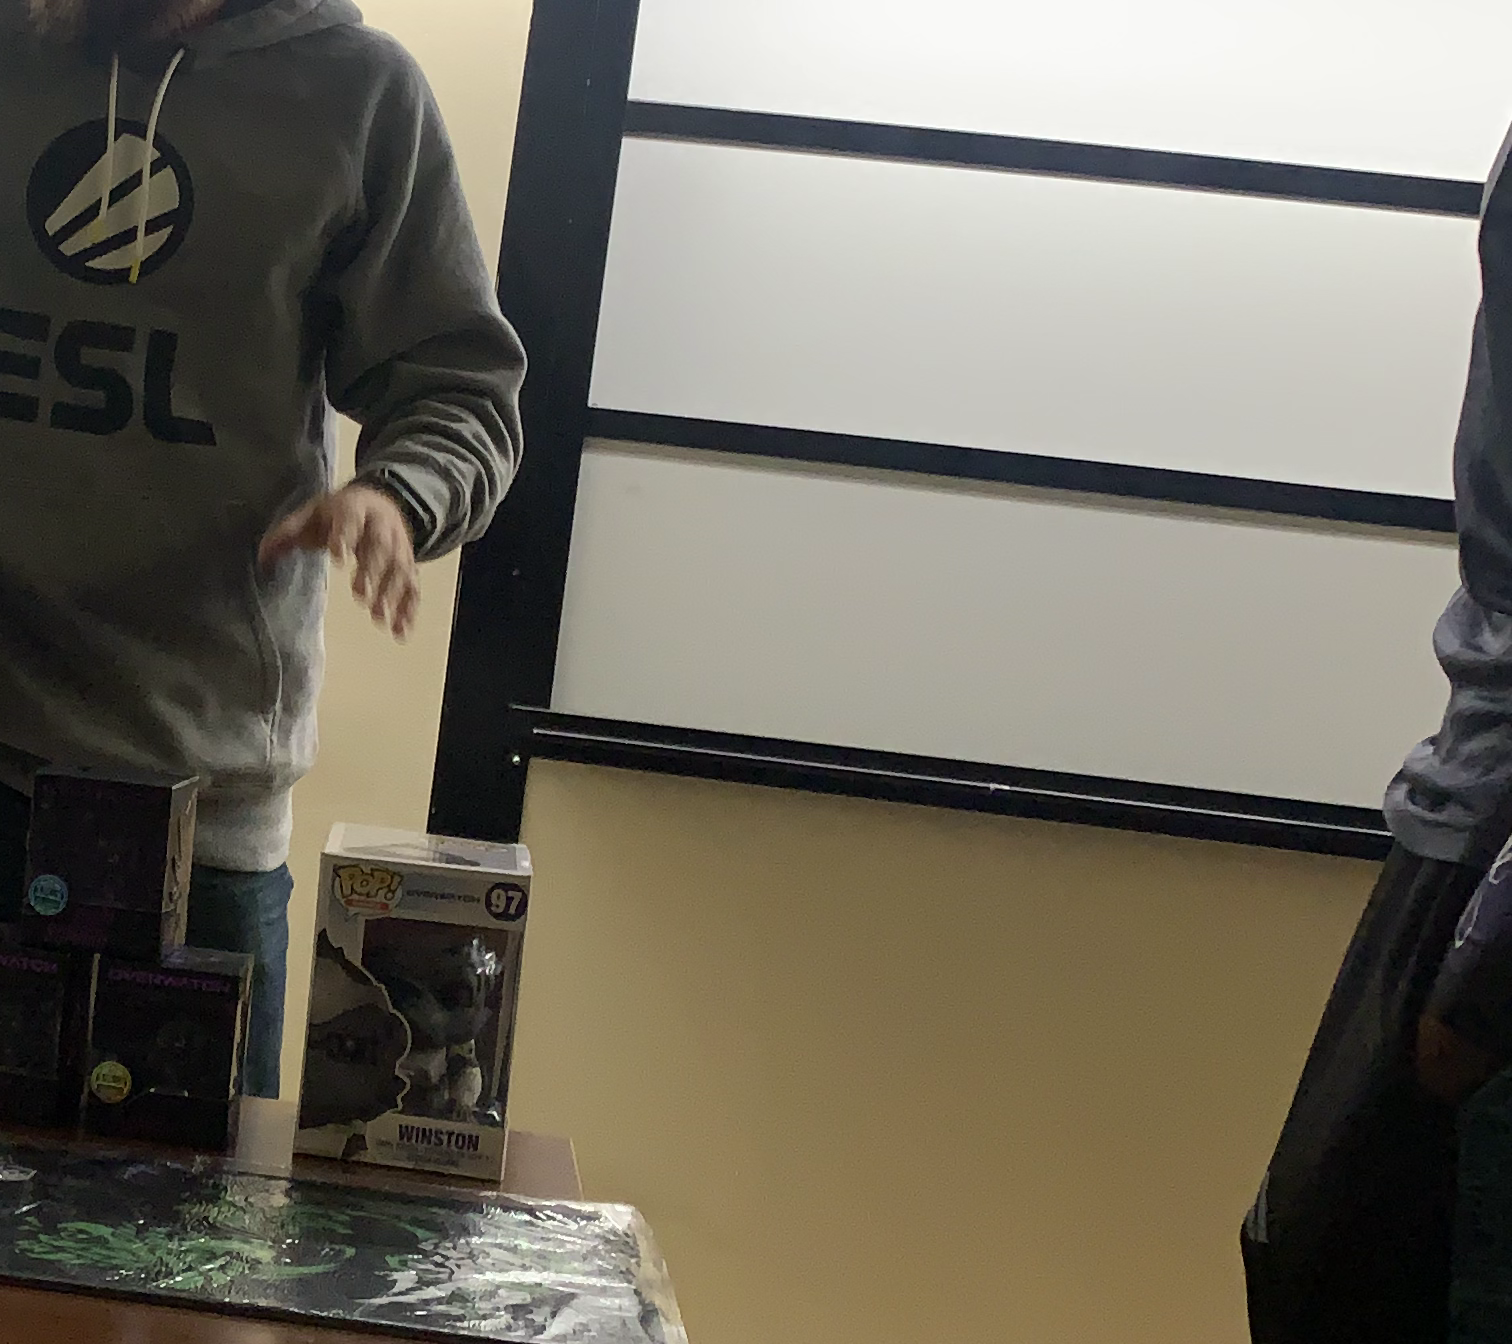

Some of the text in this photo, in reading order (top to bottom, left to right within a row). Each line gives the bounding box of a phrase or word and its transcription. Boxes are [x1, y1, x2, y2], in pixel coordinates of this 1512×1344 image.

[333, 864, 404, 902] POP!
[489, 888, 524, 915] 97
[398, 1124, 480, 1152] WINSTON
